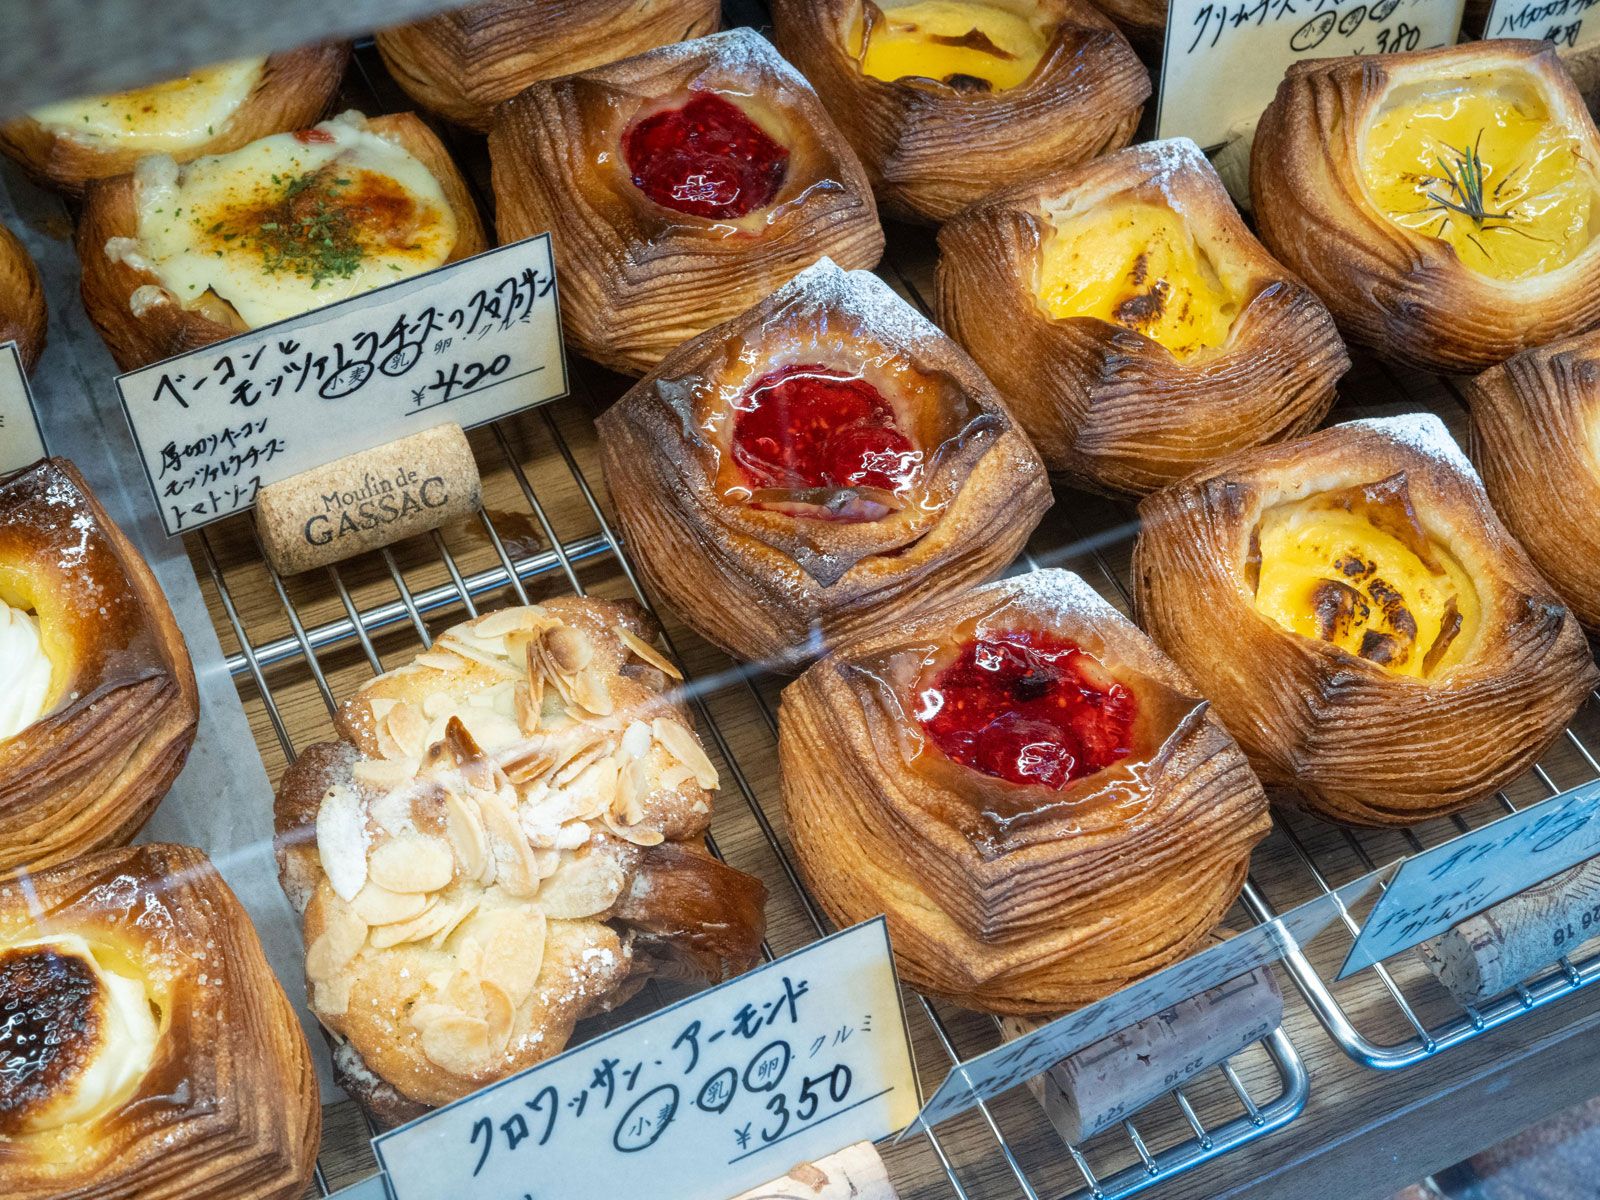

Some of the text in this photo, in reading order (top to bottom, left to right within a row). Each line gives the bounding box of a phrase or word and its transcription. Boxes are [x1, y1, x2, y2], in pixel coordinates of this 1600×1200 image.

[153, 341, 300, 408] ベーコンと
[158, 418, 268, 480] 厚切りベーコン
[163, 438, 286, 497] モッツァレラチーズ
[171, 476, 264, 529] トマトソース
[304, 476, 448, 546] GASSAC
[321, 467, 418, 512] Moulin de
[733, 1064, 852, 1150] ¥350
